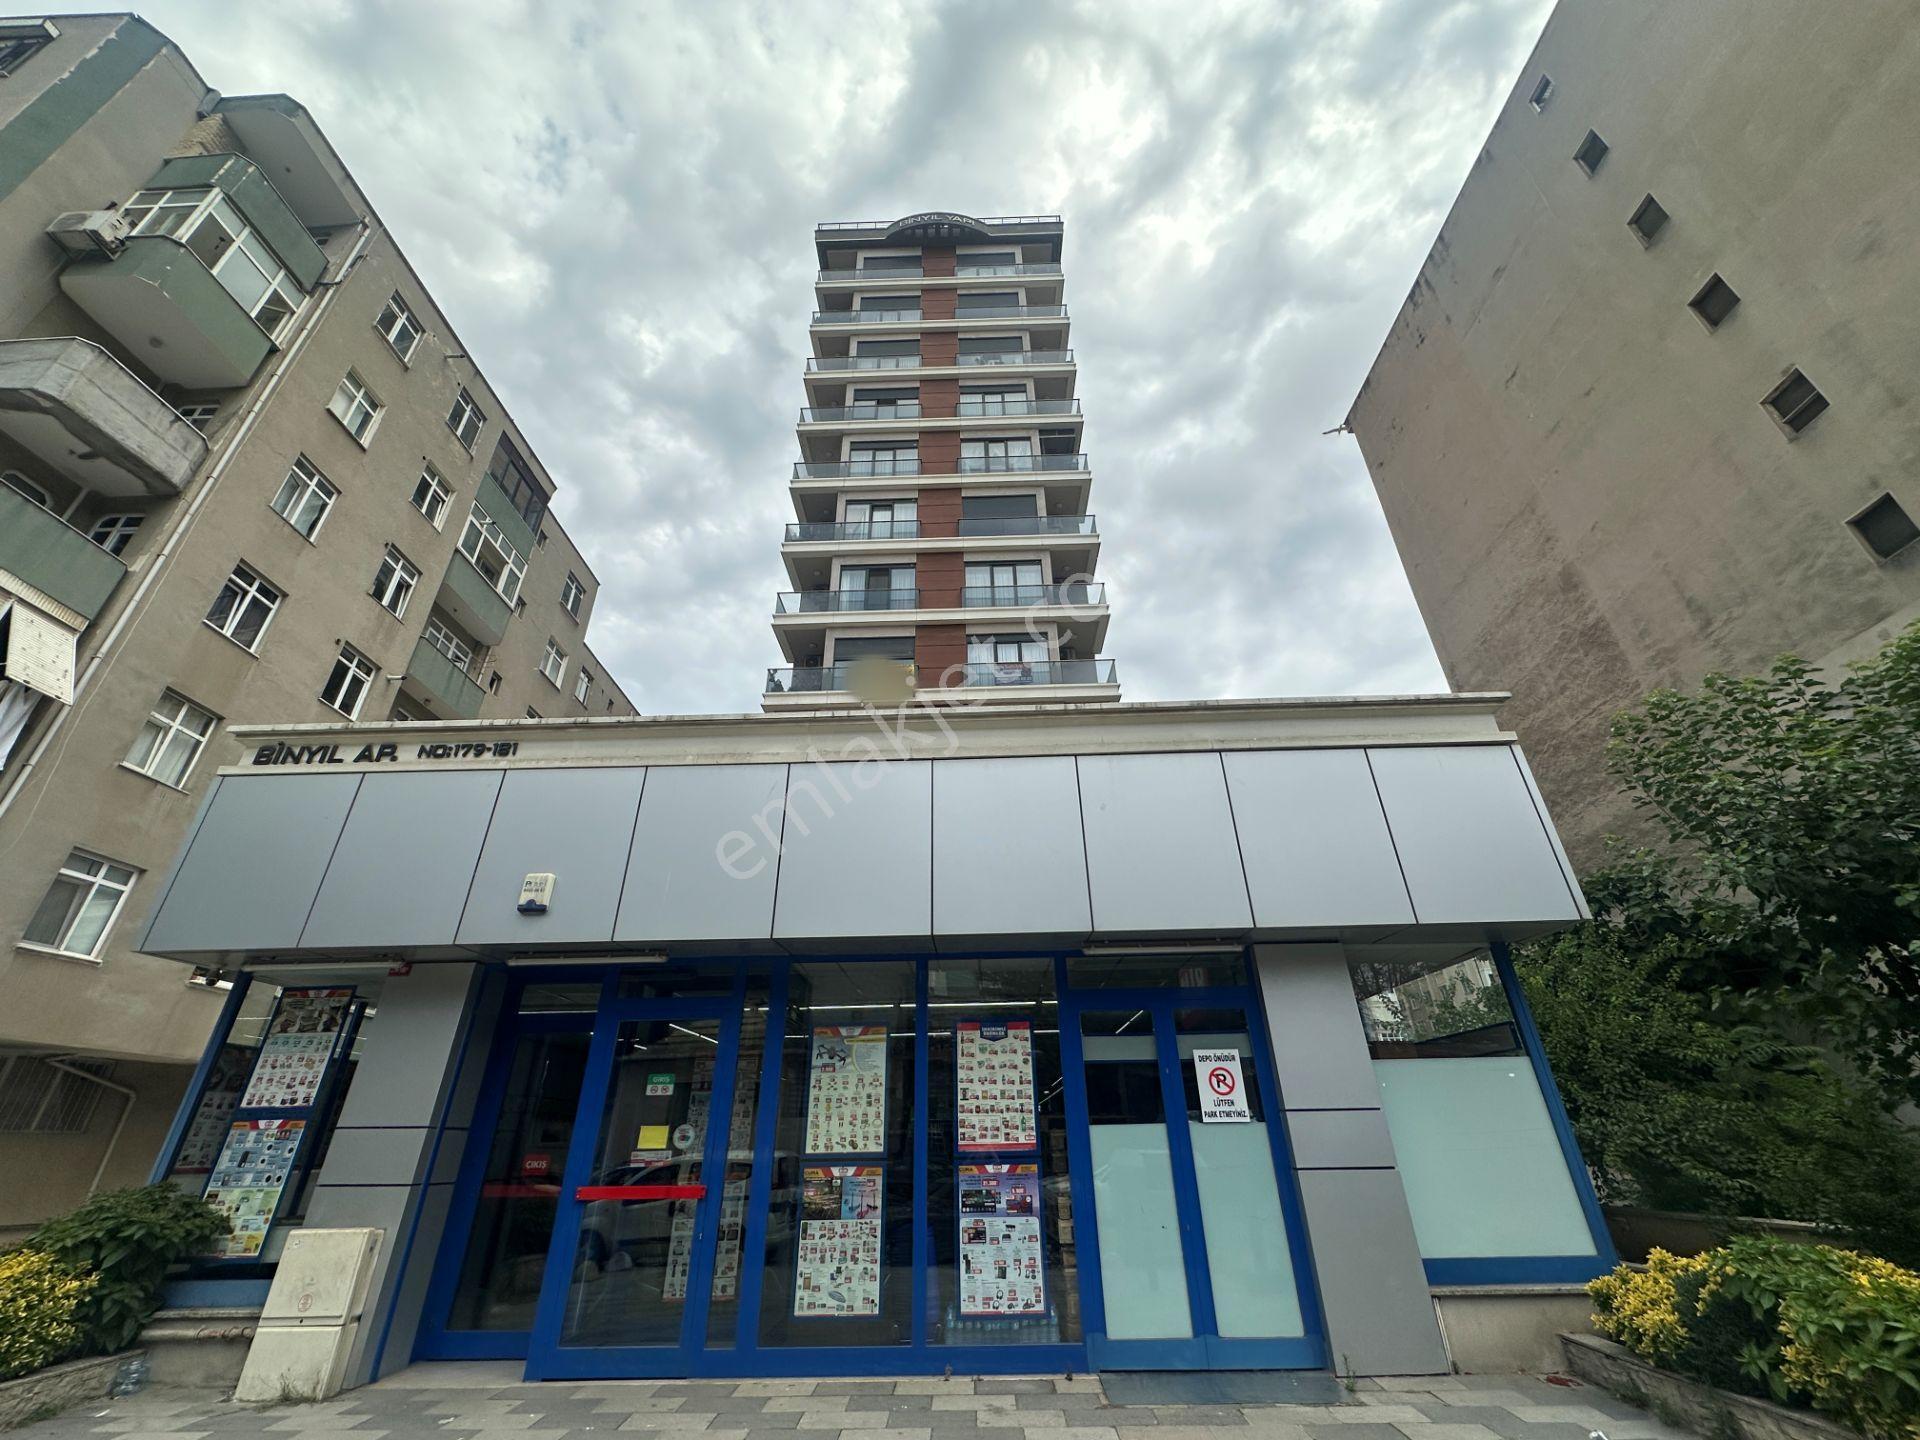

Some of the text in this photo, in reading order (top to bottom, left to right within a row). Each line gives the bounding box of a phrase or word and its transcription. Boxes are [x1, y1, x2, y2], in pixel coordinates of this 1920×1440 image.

[945, 215, 975, 225] YAPI
[252, 741, 519, 765] BİNYIL AP. NO:179-181
[1198, 1053, 1235, 1062] DEPO ÖNÜDÜR
[1213, 1098, 1234, 1106] LÜTFEN
[1204, 1110, 1218, 1118] PARK
